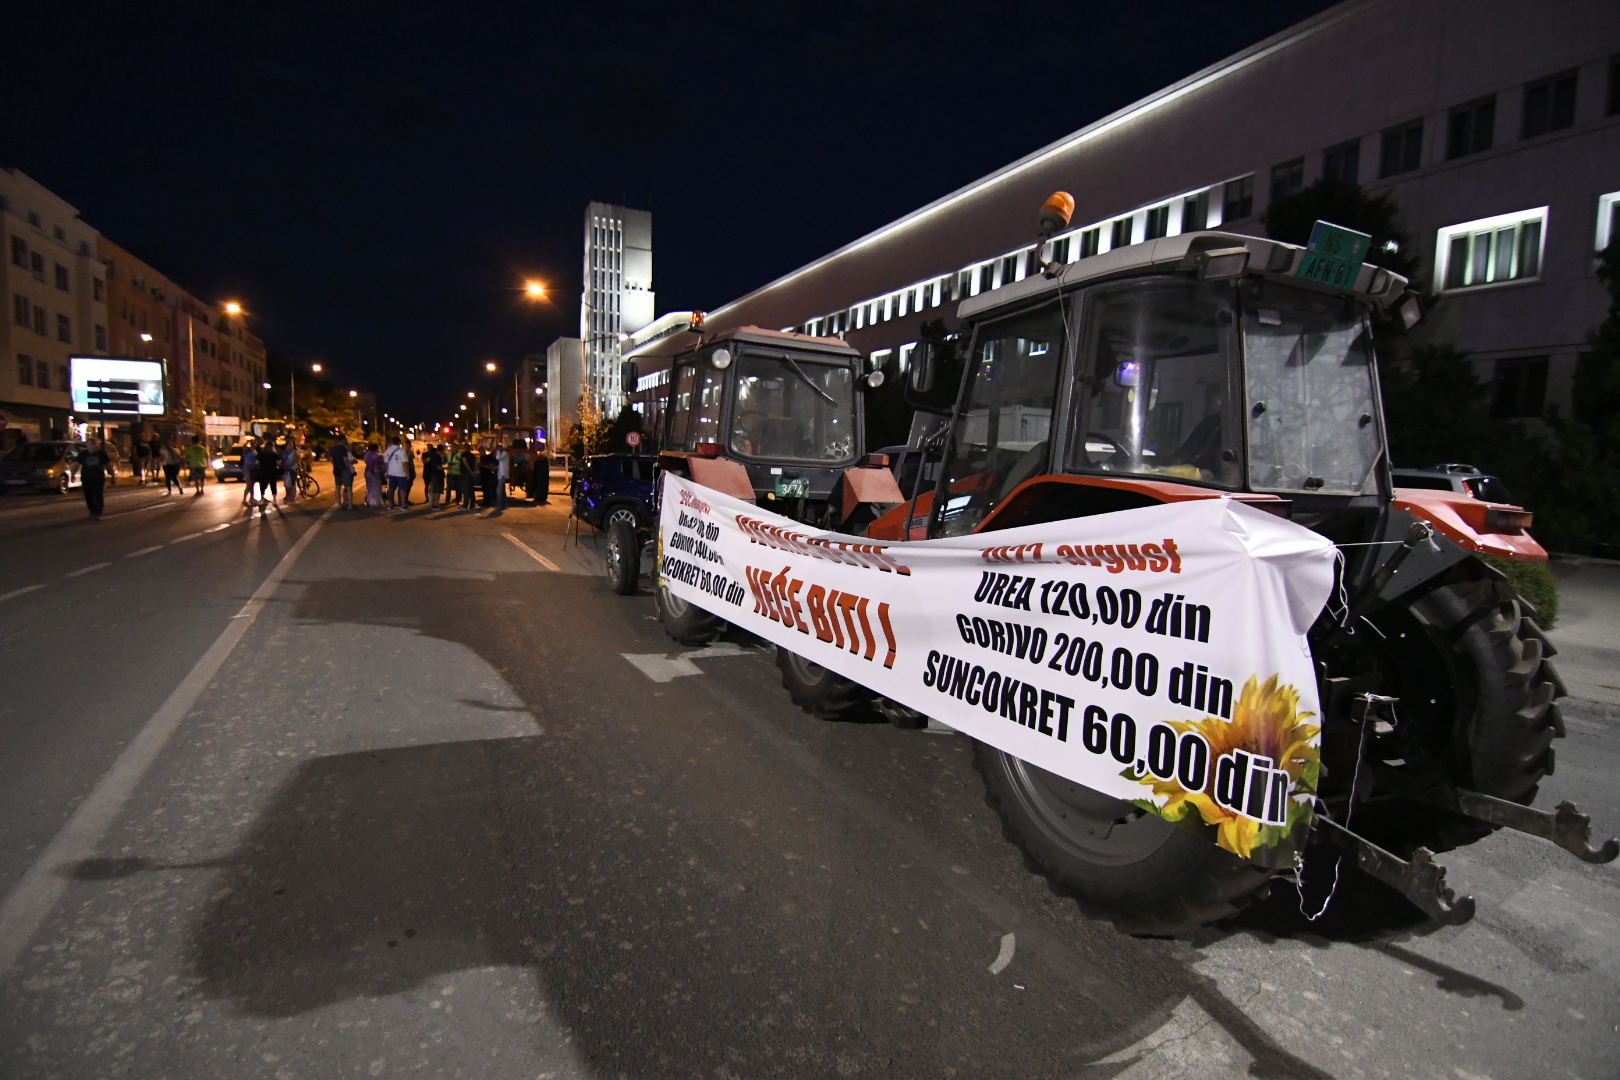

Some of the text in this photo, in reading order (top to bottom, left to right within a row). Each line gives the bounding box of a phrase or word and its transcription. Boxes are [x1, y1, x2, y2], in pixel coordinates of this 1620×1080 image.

[630, 435, 638, 443] 10
[699, 569, 727, 599] 60,00
[725, 581, 745, 607] din
[1056, 538, 1182, 574] avgust
[745, 566, 809, 635] NEĆE
[806, 583, 876, 662] BITI
[974, 570, 1211, 643] UREA 120,00 din
[955, 613, 1234, 720] GORIVO 200,00 din
[923, 650, 1288, 824] SUNCOKRET 60,00 din
